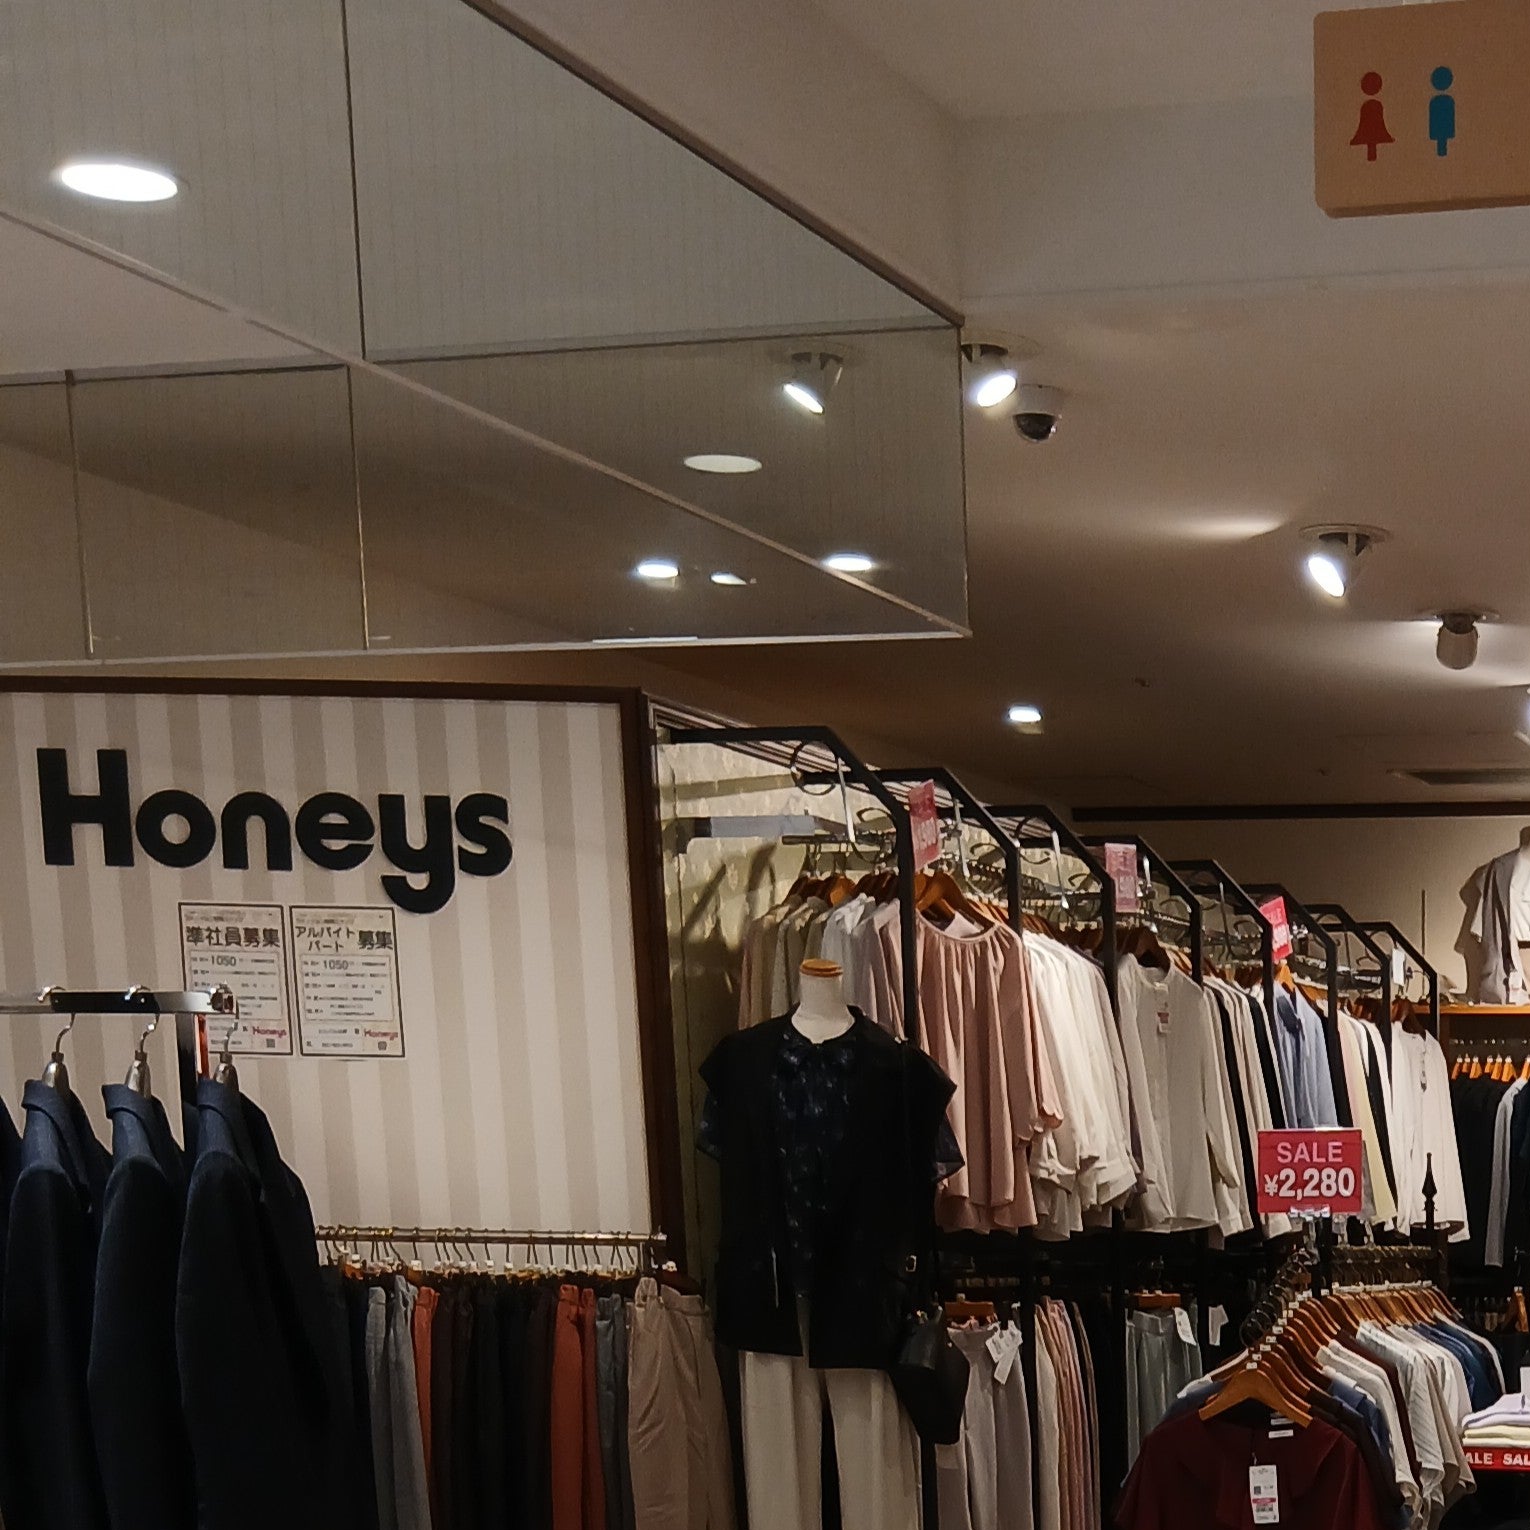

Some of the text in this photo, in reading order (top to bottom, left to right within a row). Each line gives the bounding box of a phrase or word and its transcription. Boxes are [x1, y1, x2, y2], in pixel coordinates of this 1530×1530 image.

[36, 747, 514, 914] Honeys
[295, 926, 356, 940] アルバイト
[308, 940, 345, 952] パート
[1276, 1141, 1343, 1164] SALE
[1263, 1167, 1356, 1201] ¥2,280
[1465, 1452, 1493, 1465] ALE
